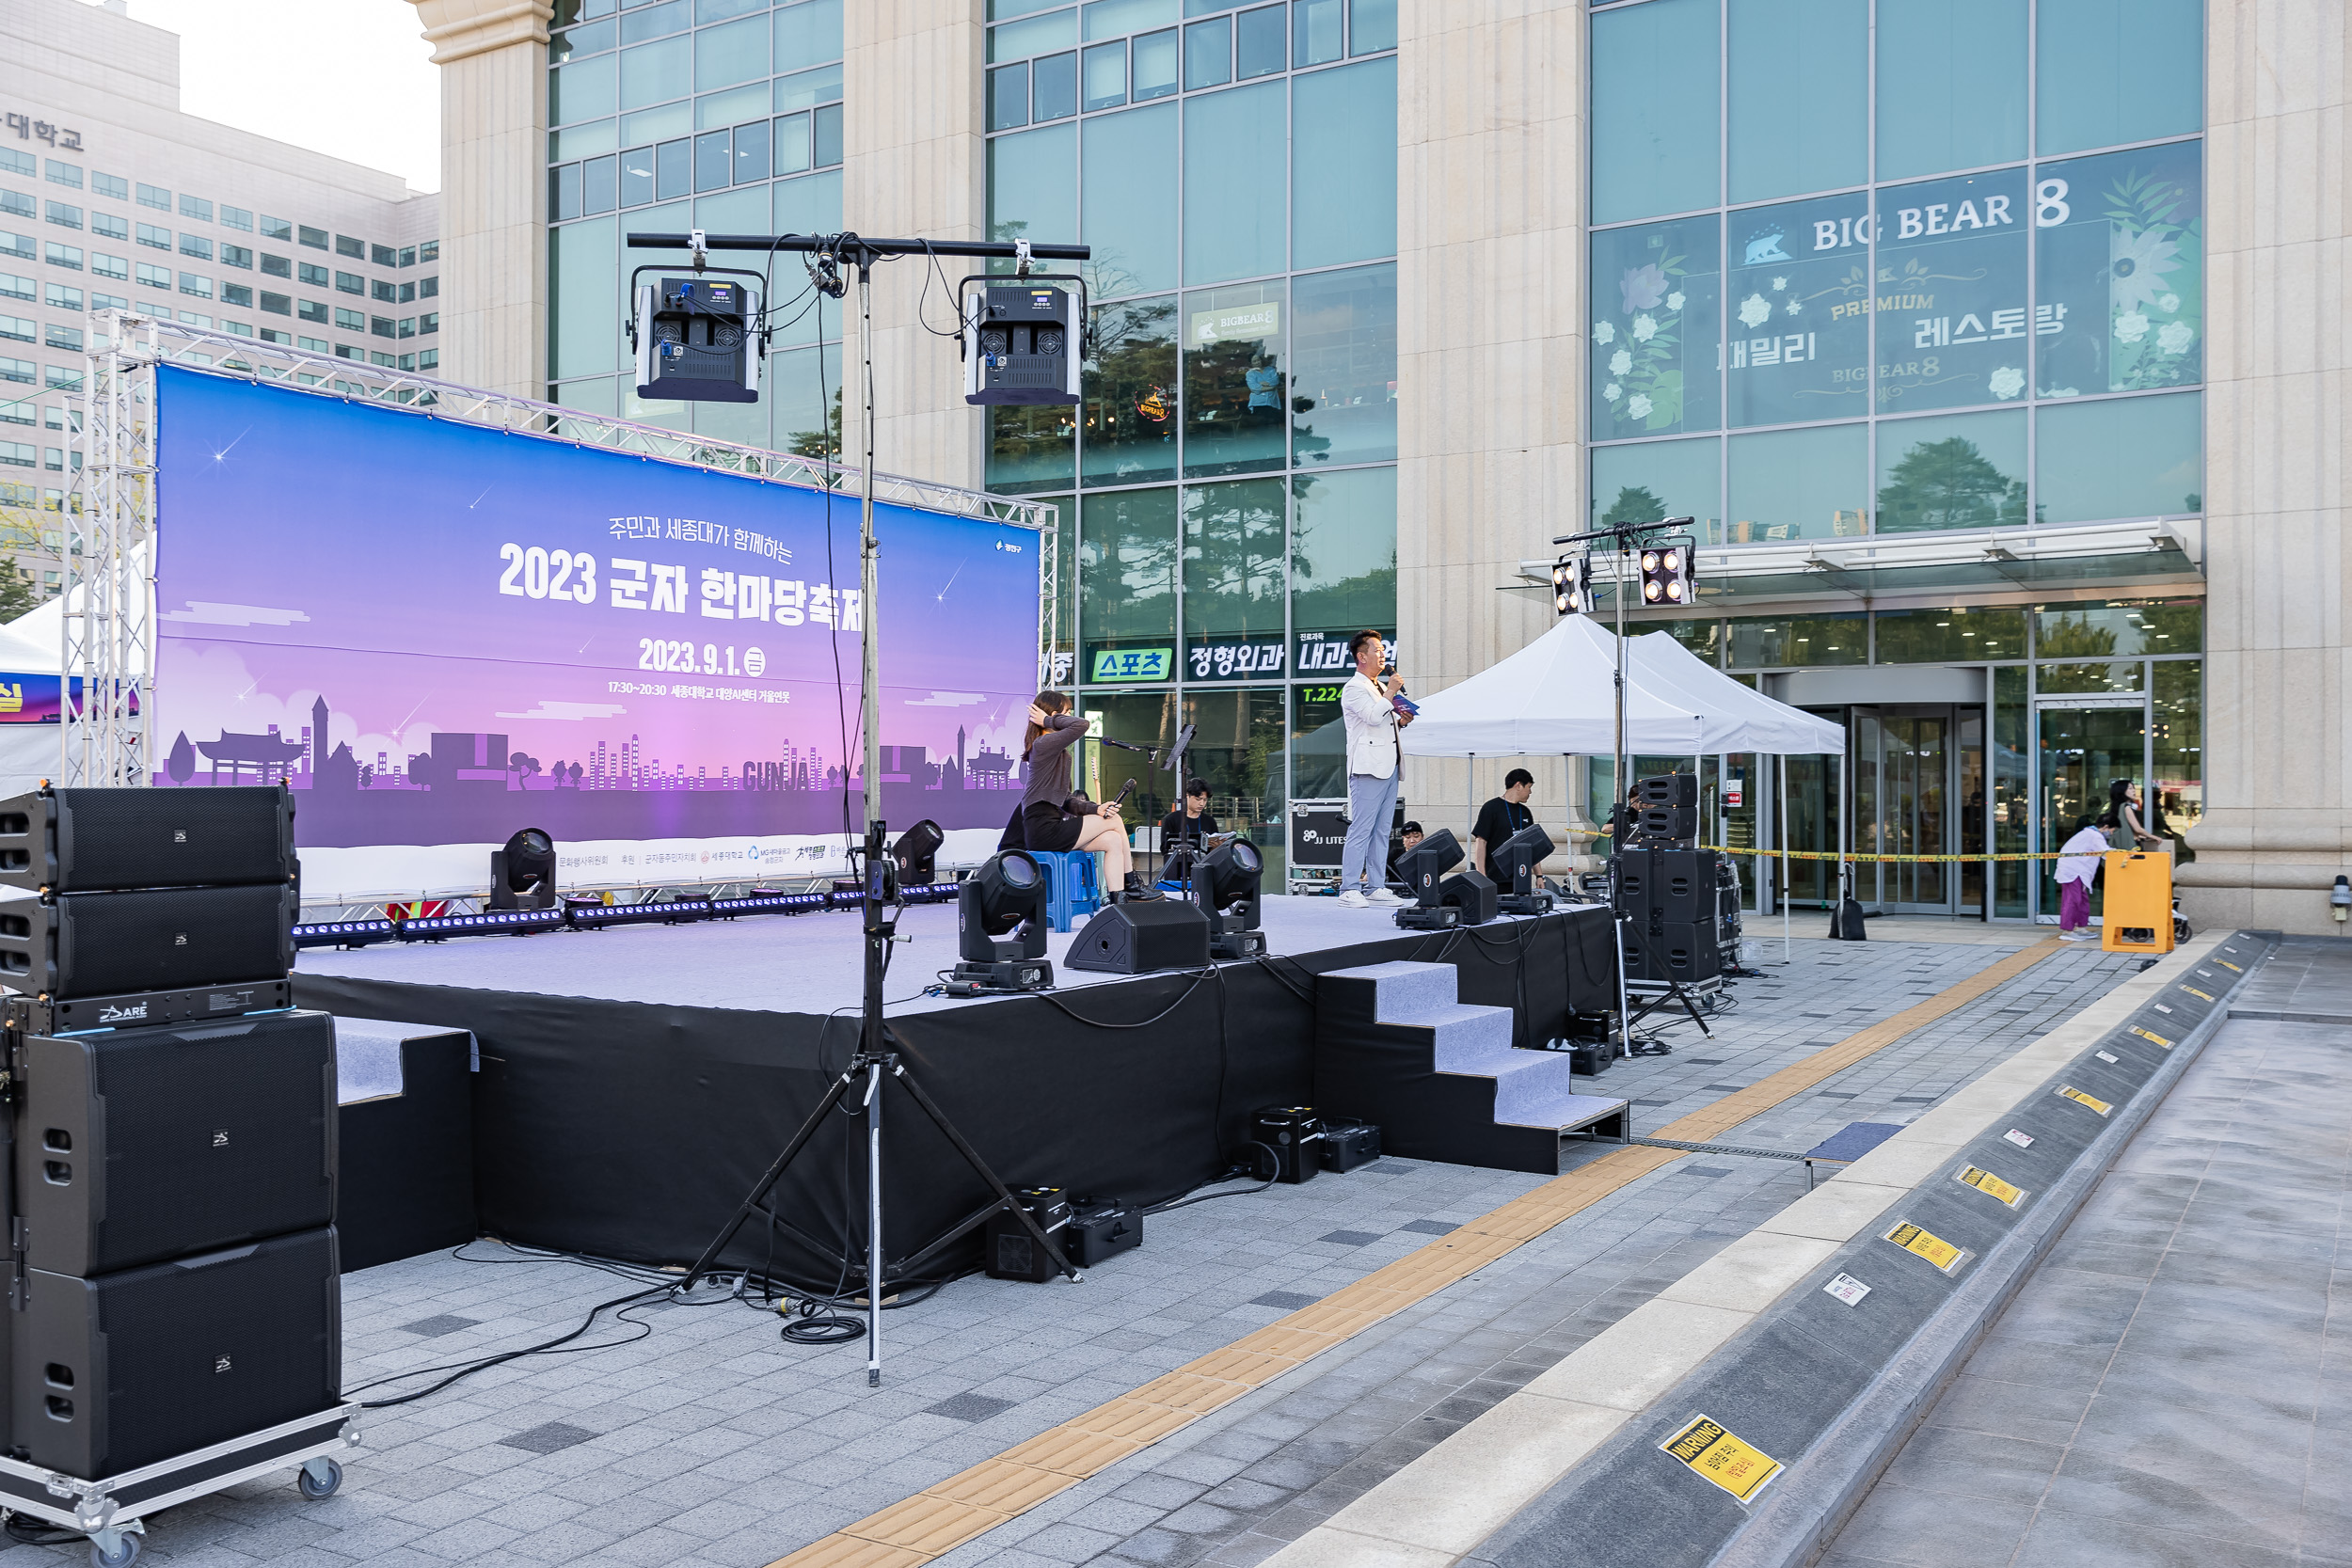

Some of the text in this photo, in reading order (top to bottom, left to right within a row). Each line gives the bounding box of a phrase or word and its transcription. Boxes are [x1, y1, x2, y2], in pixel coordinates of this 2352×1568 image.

[0, 112, 85, 151] 대학교
[1813, 178, 2071, 251] BIG BEAR 8
[1831, 293, 1935, 322] PREMIUM
[1915, 302, 2069, 349] 레스토랑
[1831, 356, 1940, 384] BIGEAR8
[609, 515, 793, 565] 주민과 세종대가 함께하는
[499, 542, 596, 605] 2023
[610, 557, 689, 614] 군자
[1299, 632, 1325, 641] 진료과목
[1098, 652, 1163, 677] 스포츠
[1189, 642, 1285, 678] 정형외과
[608, 681, 790, 705] 17:30~20:30 세종대학교 대양AI센터 거울연못
[1671, 1422, 1722, 1460] WARNING
[1720, 1444, 1739, 1456] 주의
